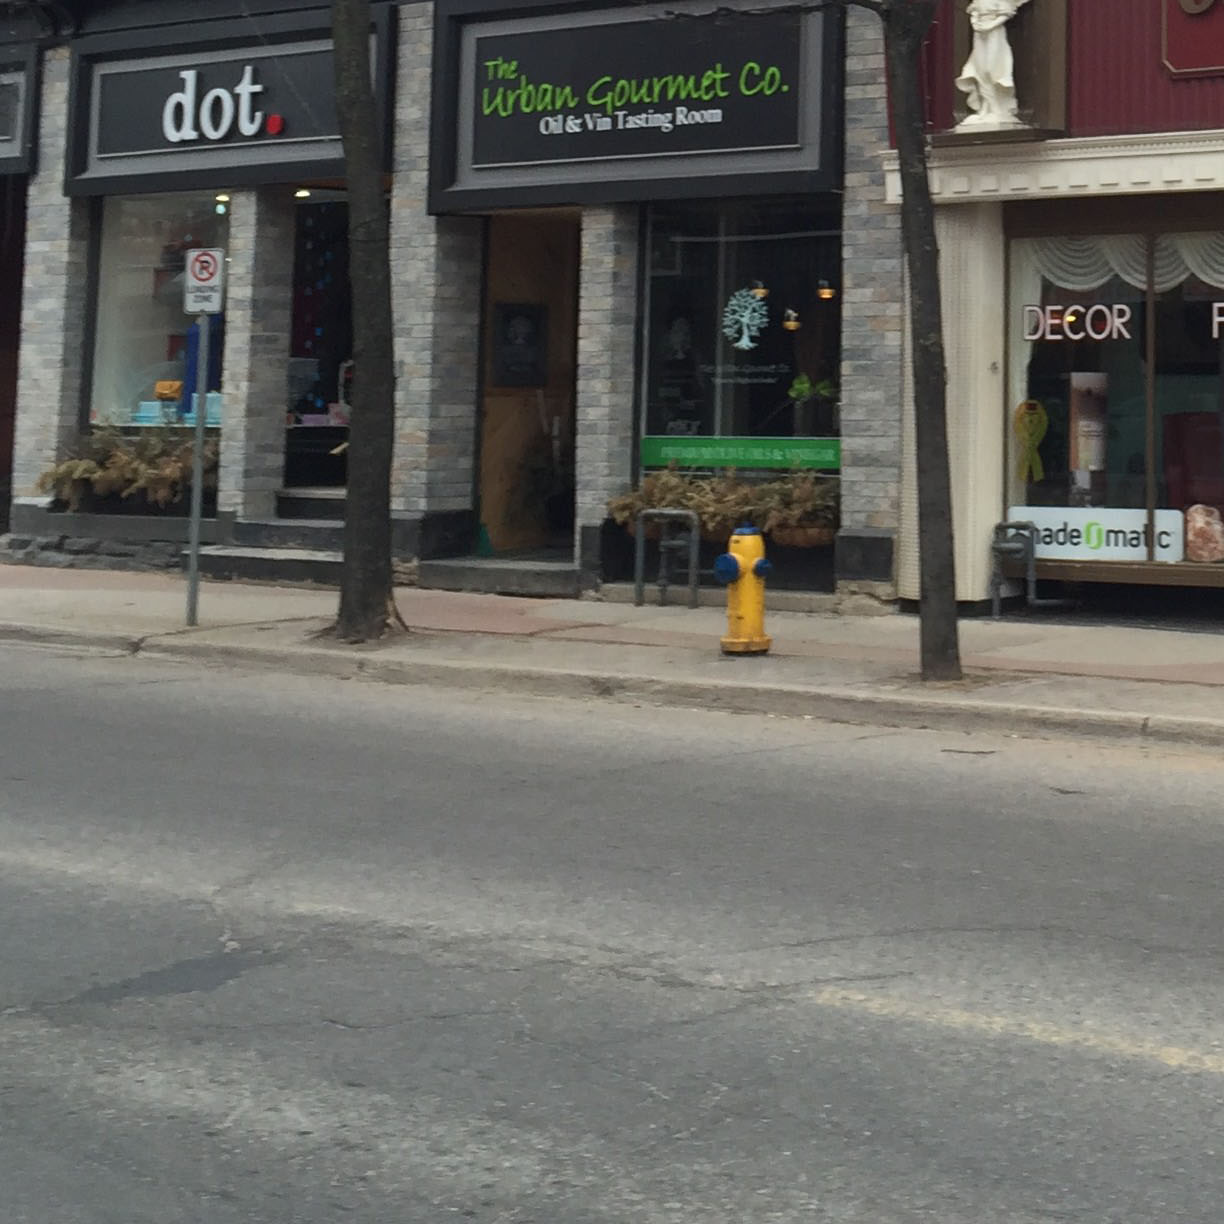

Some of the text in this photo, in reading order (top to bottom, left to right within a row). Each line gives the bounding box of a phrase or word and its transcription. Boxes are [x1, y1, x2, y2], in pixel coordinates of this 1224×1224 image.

[483, 57, 519, 81] The
[482, 62, 789, 117] Urban Gourmet Co.
[539, 106, 723, 135] Oil & Vin Tasting Room
[1023, 303, 1132, 341] DECOR
